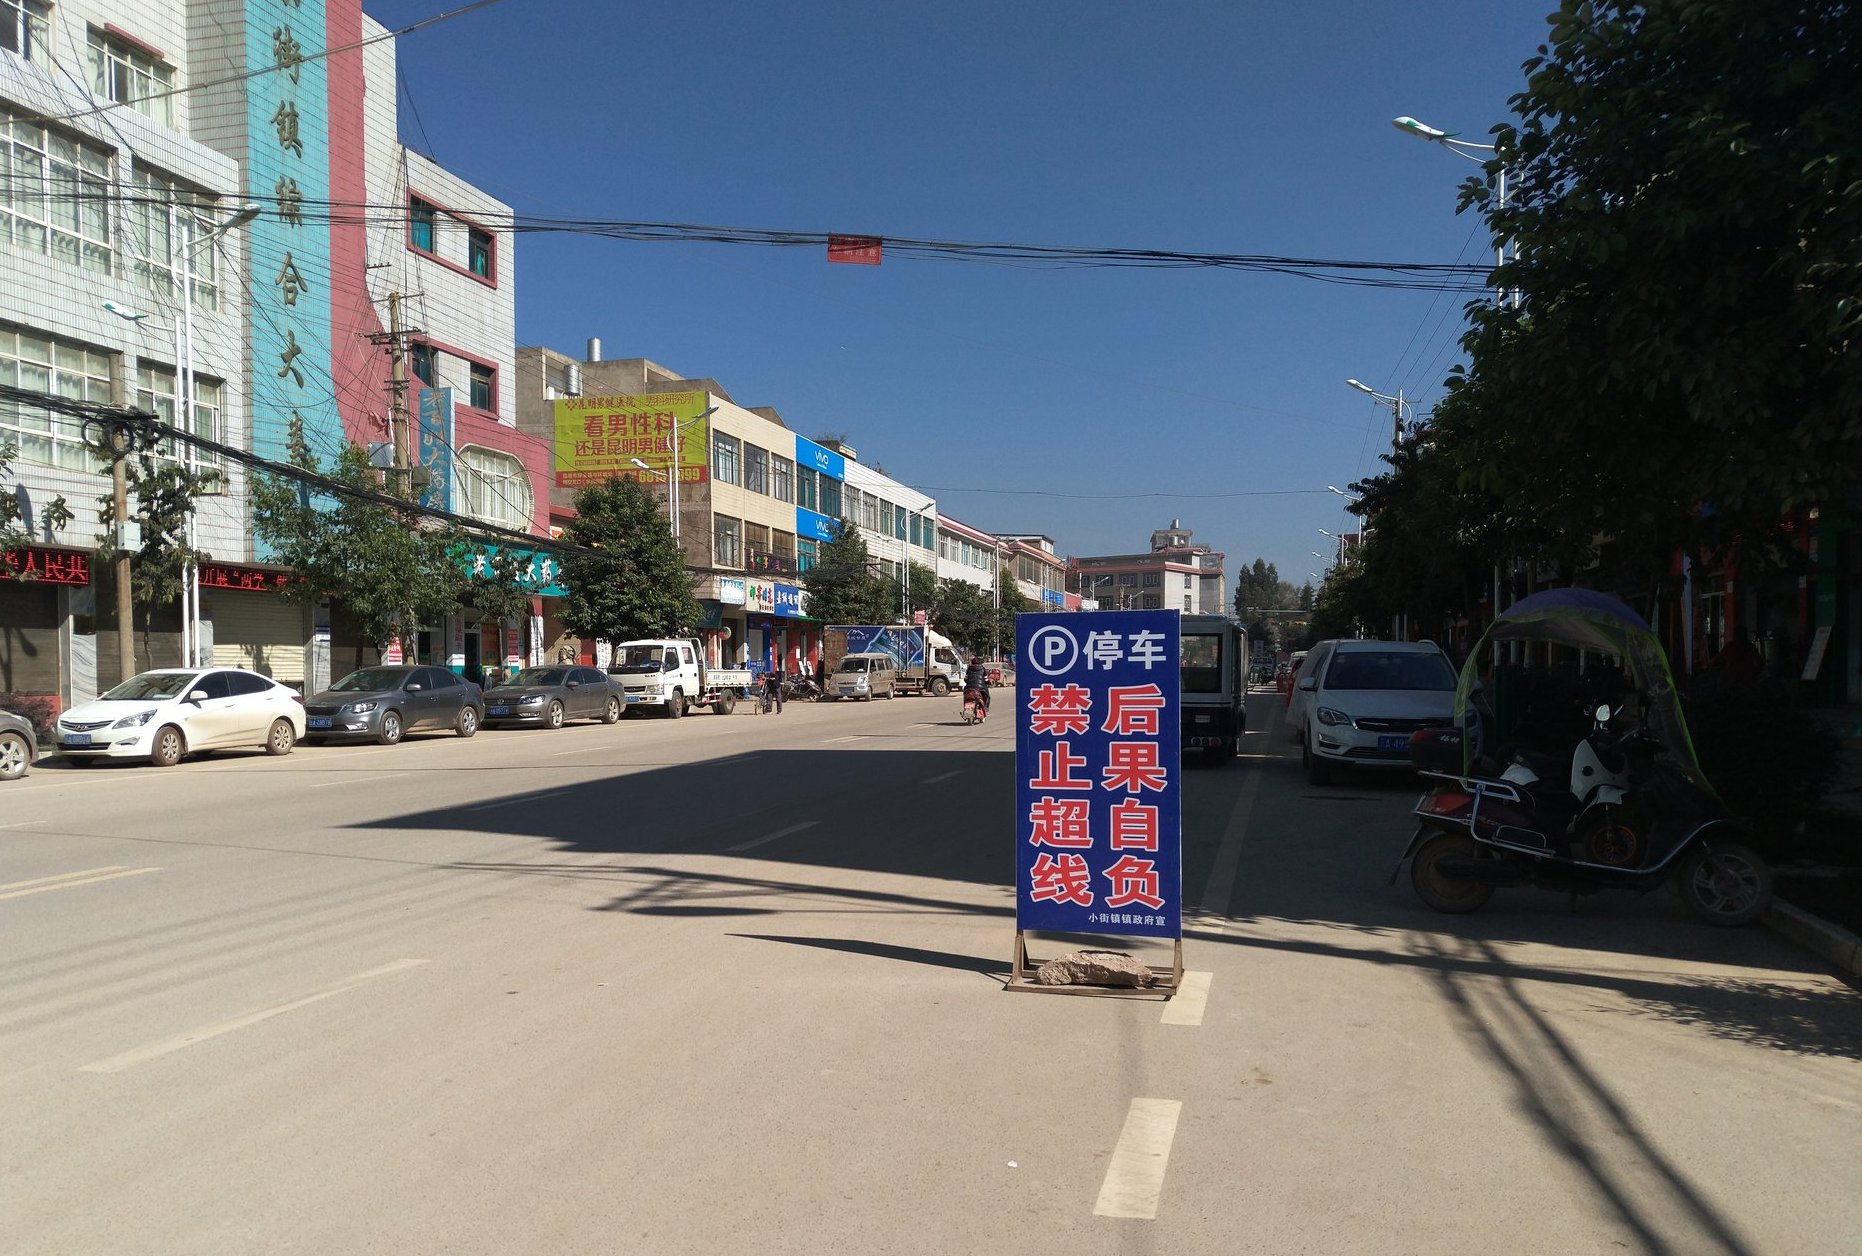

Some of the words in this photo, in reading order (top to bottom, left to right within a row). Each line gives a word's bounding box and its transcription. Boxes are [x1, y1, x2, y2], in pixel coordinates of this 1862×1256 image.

[583, 411, 675, 438] 看男性科
[574, 435, 686, 457] 还是昆明男健好
[1082, 629, 1167, 671] 停车
[1027, 683, 1094, 908] 禁止超线
[1100, 683, 1168, 909] 后果自负
[1088, 912, 1166, 926] 小街镇镇政府宣
